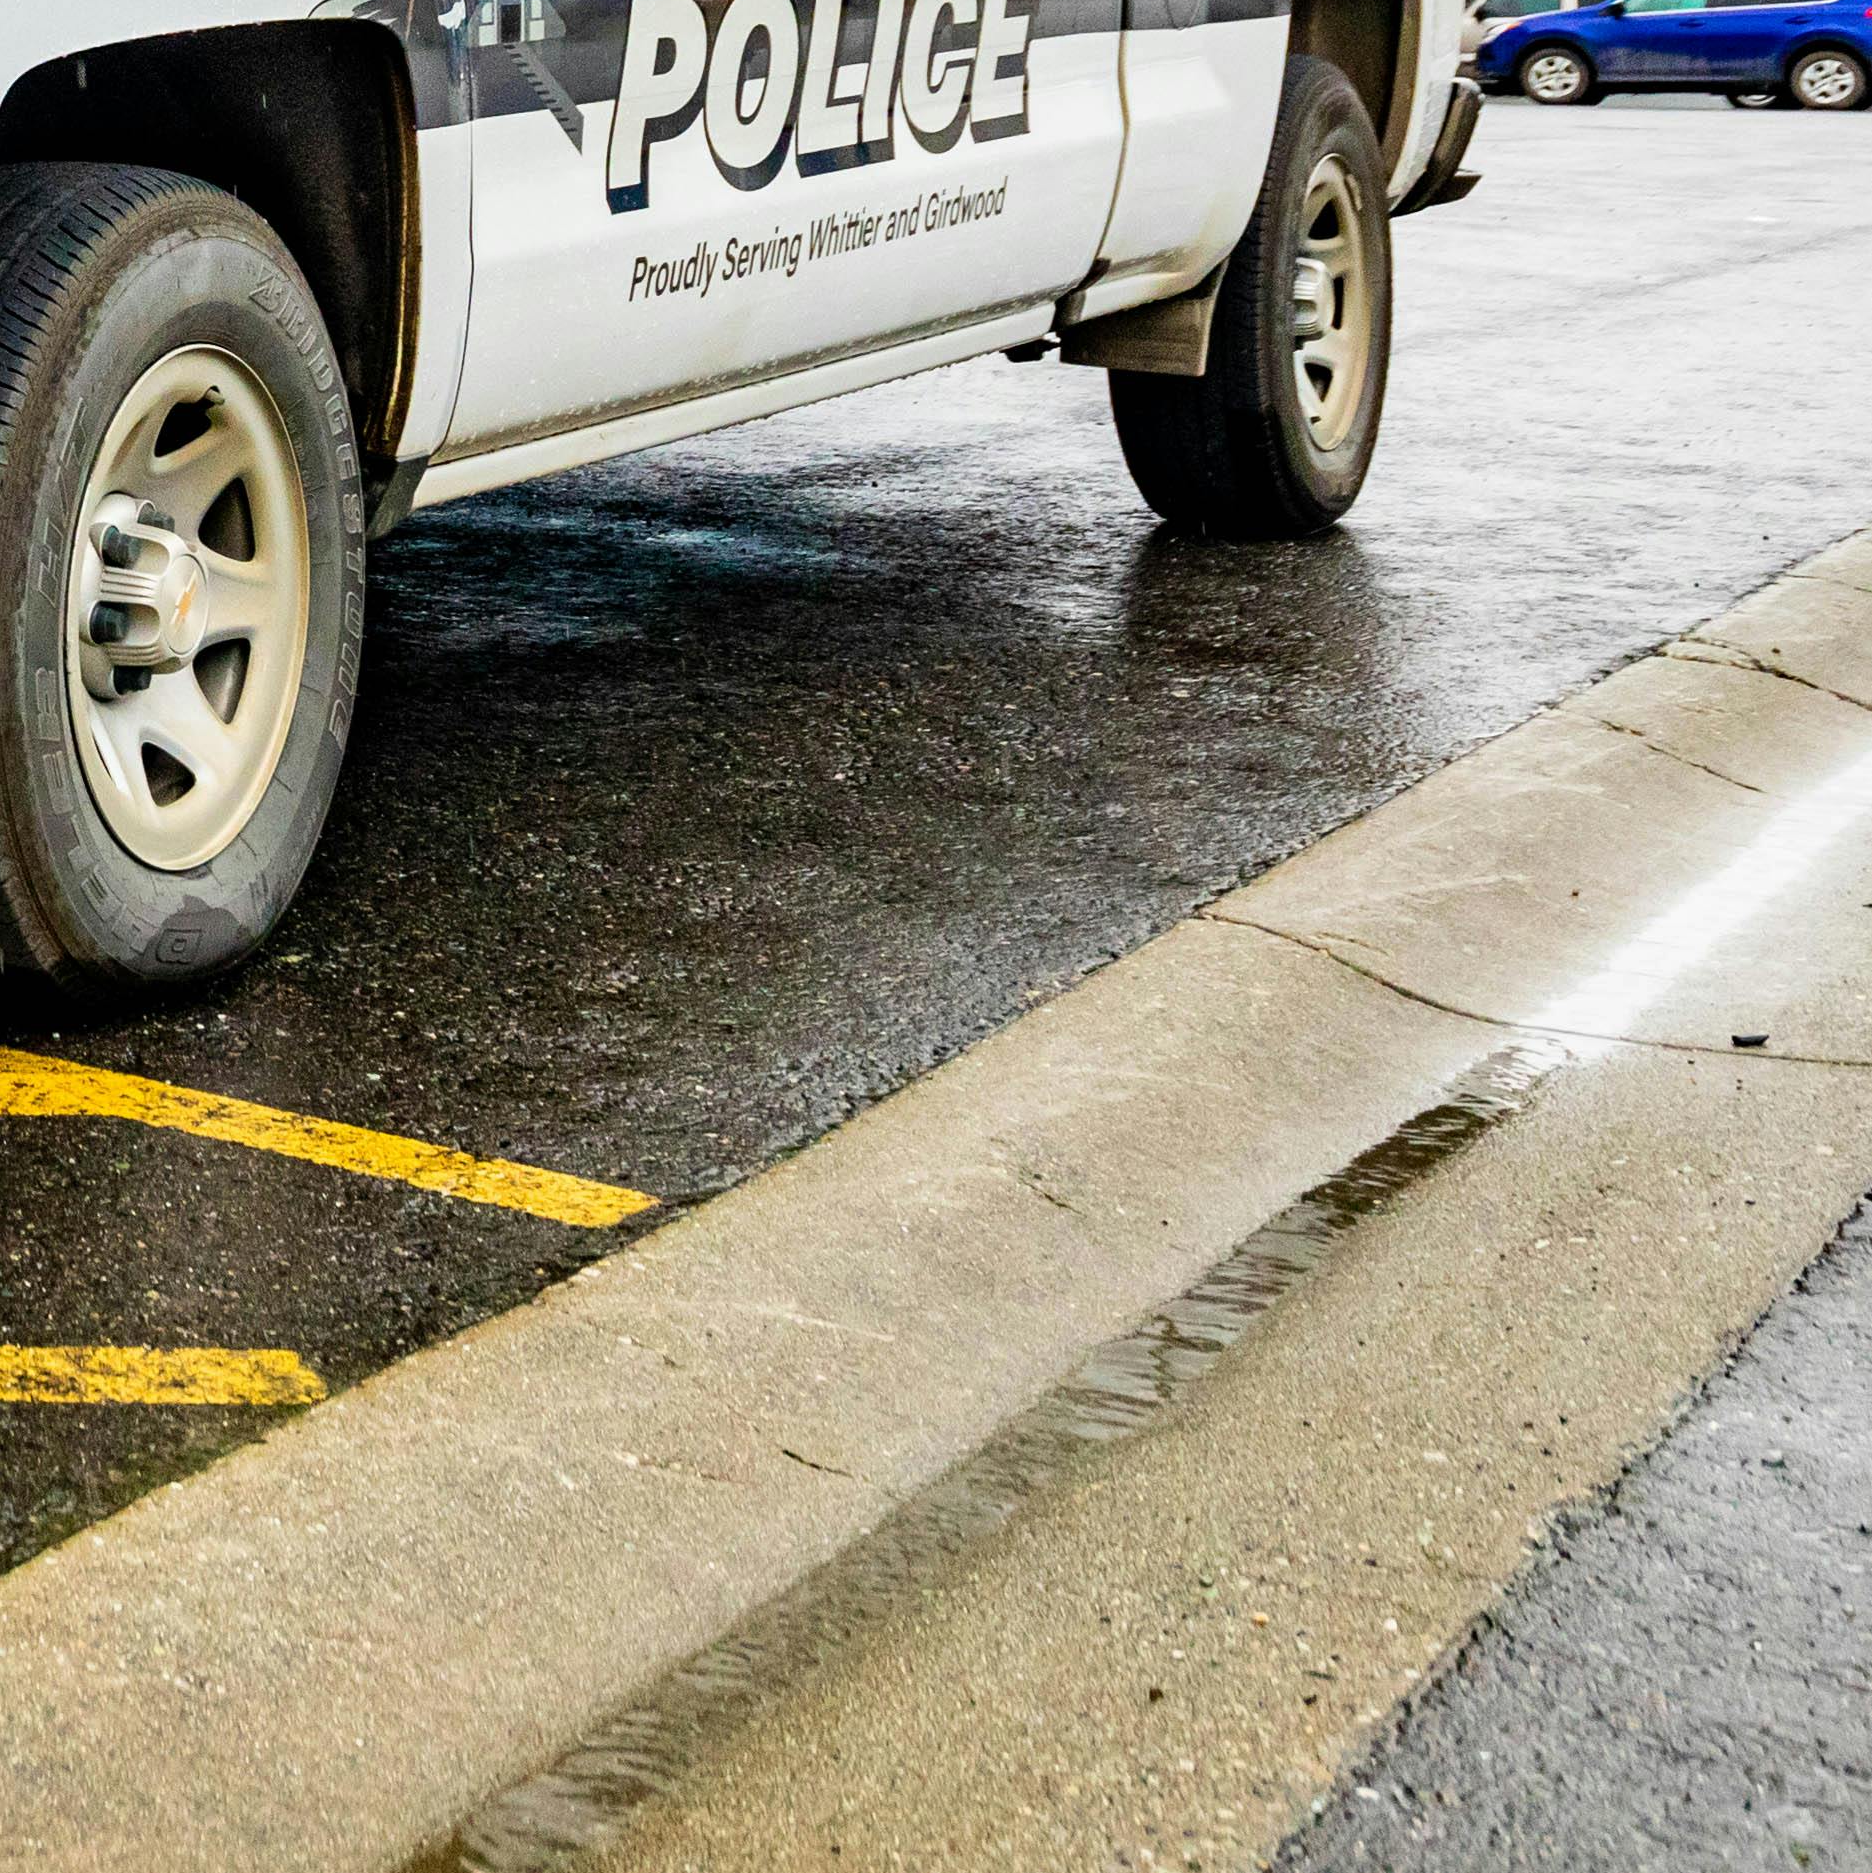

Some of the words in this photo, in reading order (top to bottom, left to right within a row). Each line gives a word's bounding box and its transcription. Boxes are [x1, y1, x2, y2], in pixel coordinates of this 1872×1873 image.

[628, 240, 719, 303] Proudly
[722, 226, 803, 278] Serving
[808, 206, 884, 261] Whittier
[885, 194, 922, 242] and
[924, 175, 1009, 233] Girdwood
